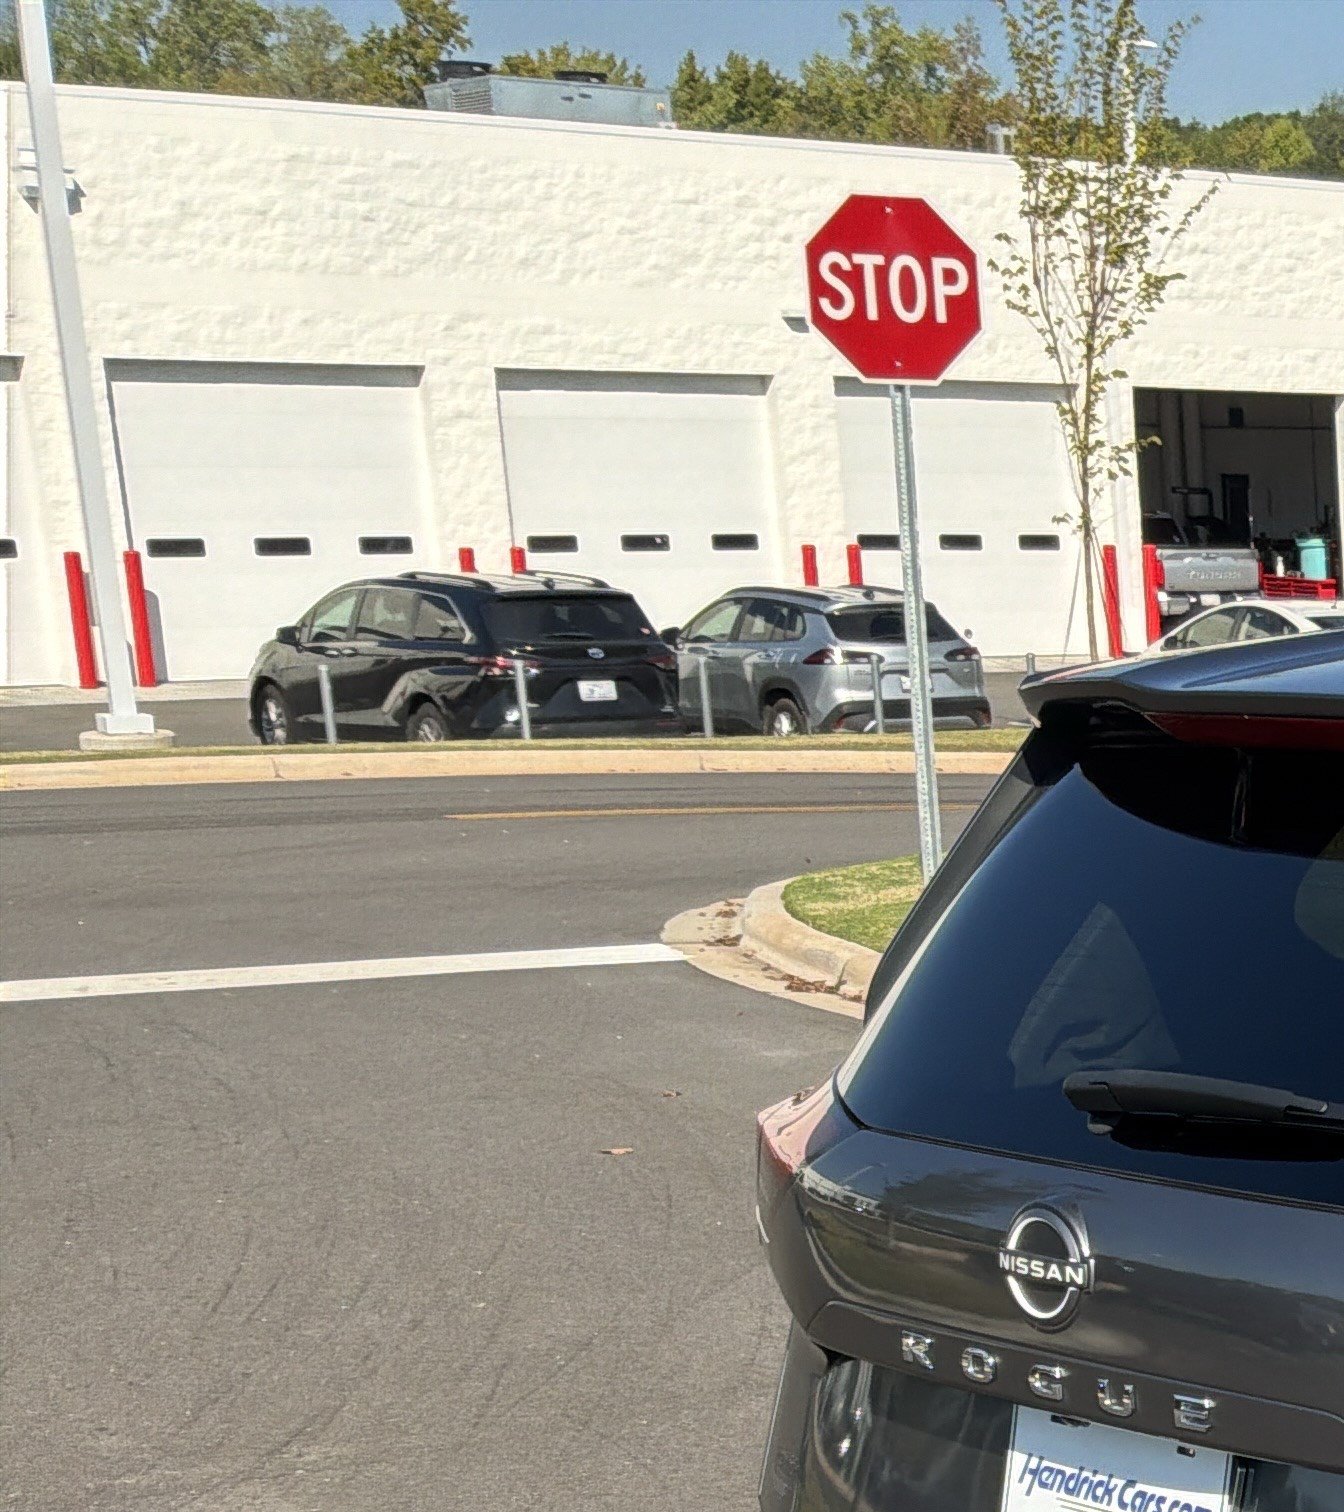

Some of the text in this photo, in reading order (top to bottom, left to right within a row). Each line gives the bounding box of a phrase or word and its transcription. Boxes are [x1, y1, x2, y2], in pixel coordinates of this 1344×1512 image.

[818, 251, 969, 324] STOP
[999, 1251, 1084, 1285] NISSAN
[901, 1330, 1216, 1432] ROGUE
